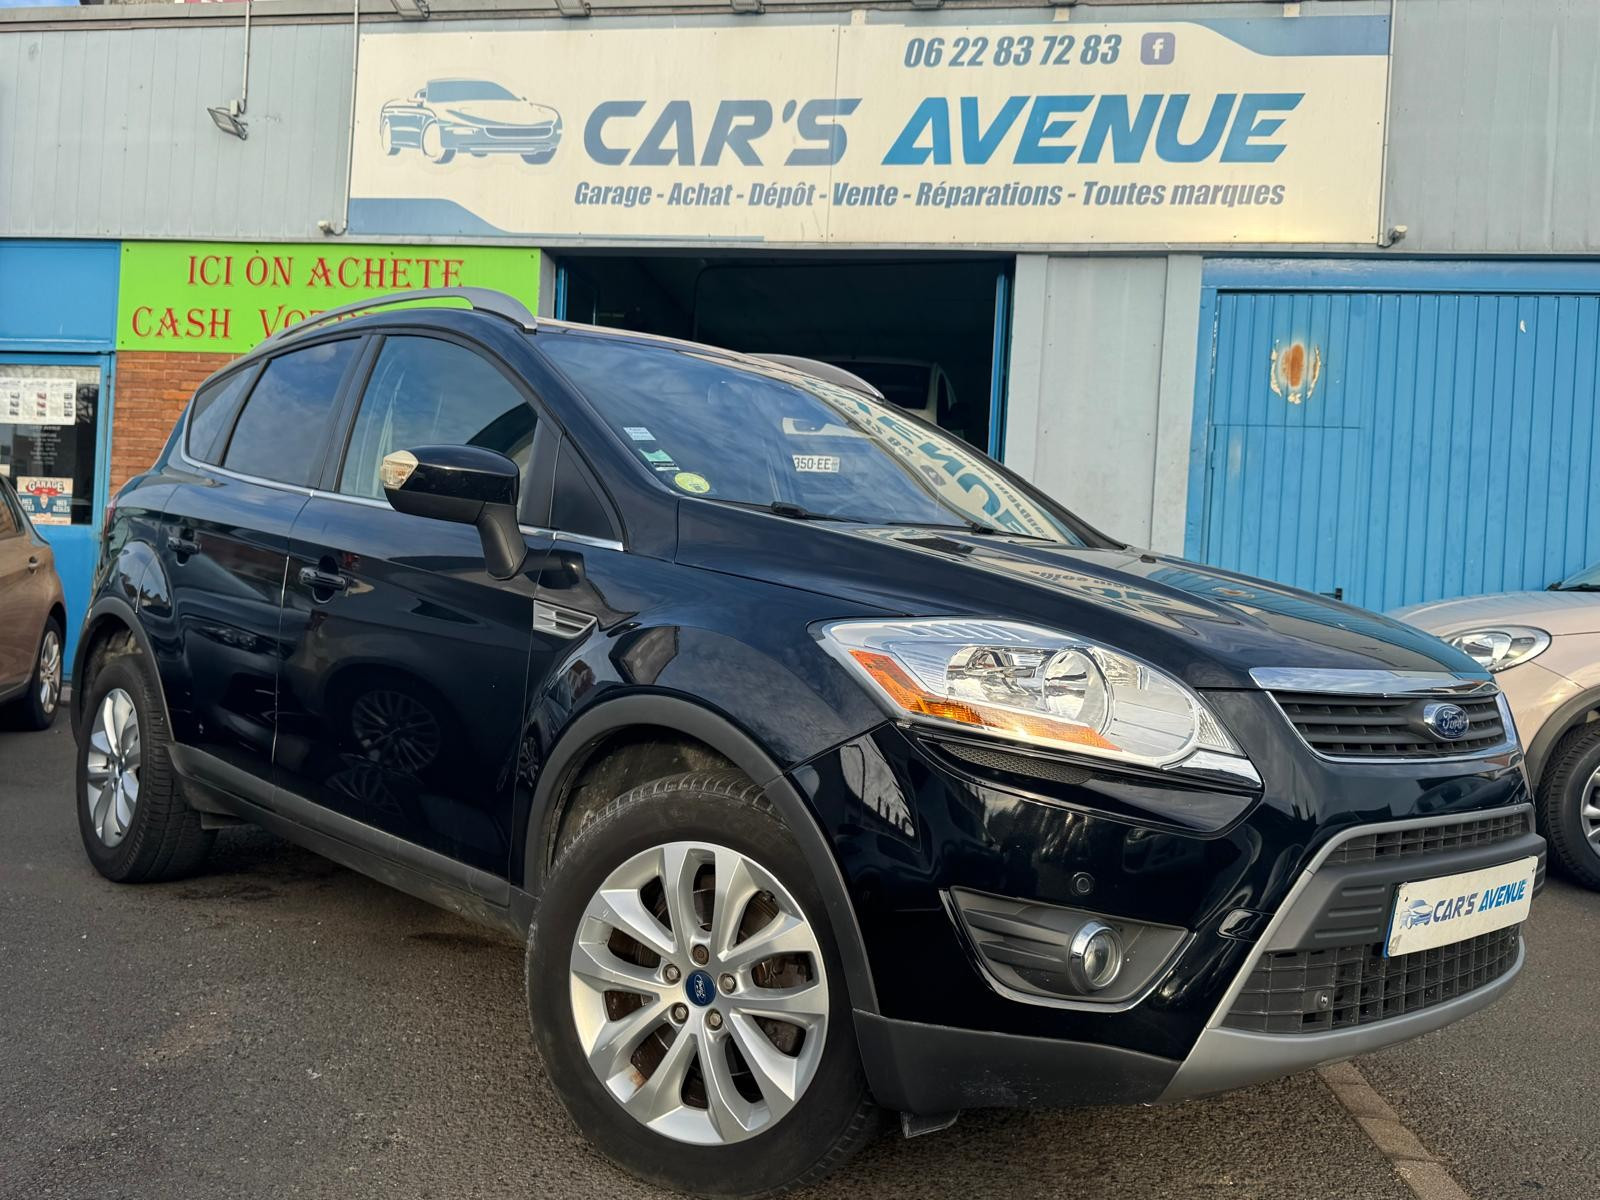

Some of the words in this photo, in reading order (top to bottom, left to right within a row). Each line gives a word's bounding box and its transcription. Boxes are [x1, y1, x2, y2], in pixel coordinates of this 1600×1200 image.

[904, 37, 945, 68] 06
[948, 36, 989, 67] 22
[993, 36, 1034, 66] 83
[1039, 35, 1075, 65] 72
[1079, 34, 1122, 65] 83
[584, 98, 862, 166] CAR'S
[881, 93, 1306, 165] AVENUE
[574, 182, 652, 208] Garage
[667, 182, 733, 206] Achat
[748, 182, 816, 208] Dépôt
[832, 182, 898, 206] Vente
[915, 181, 1063, 208] Réparations
[1083, 181, 1166, 206] Toutes
[1170, 184, 1285, 207] marques
[188, 256, 233, 287] ICI
[245, 256, 294, 287] ON
[307, 256, 466, 289] ACHETE
[132, 306, 231, 340] CASH
[1442, 709, 1465, 730] Ford
[1433, 893, 1479, 923] CAR'S
[1478, 879, 1528, 912] AVENUE
